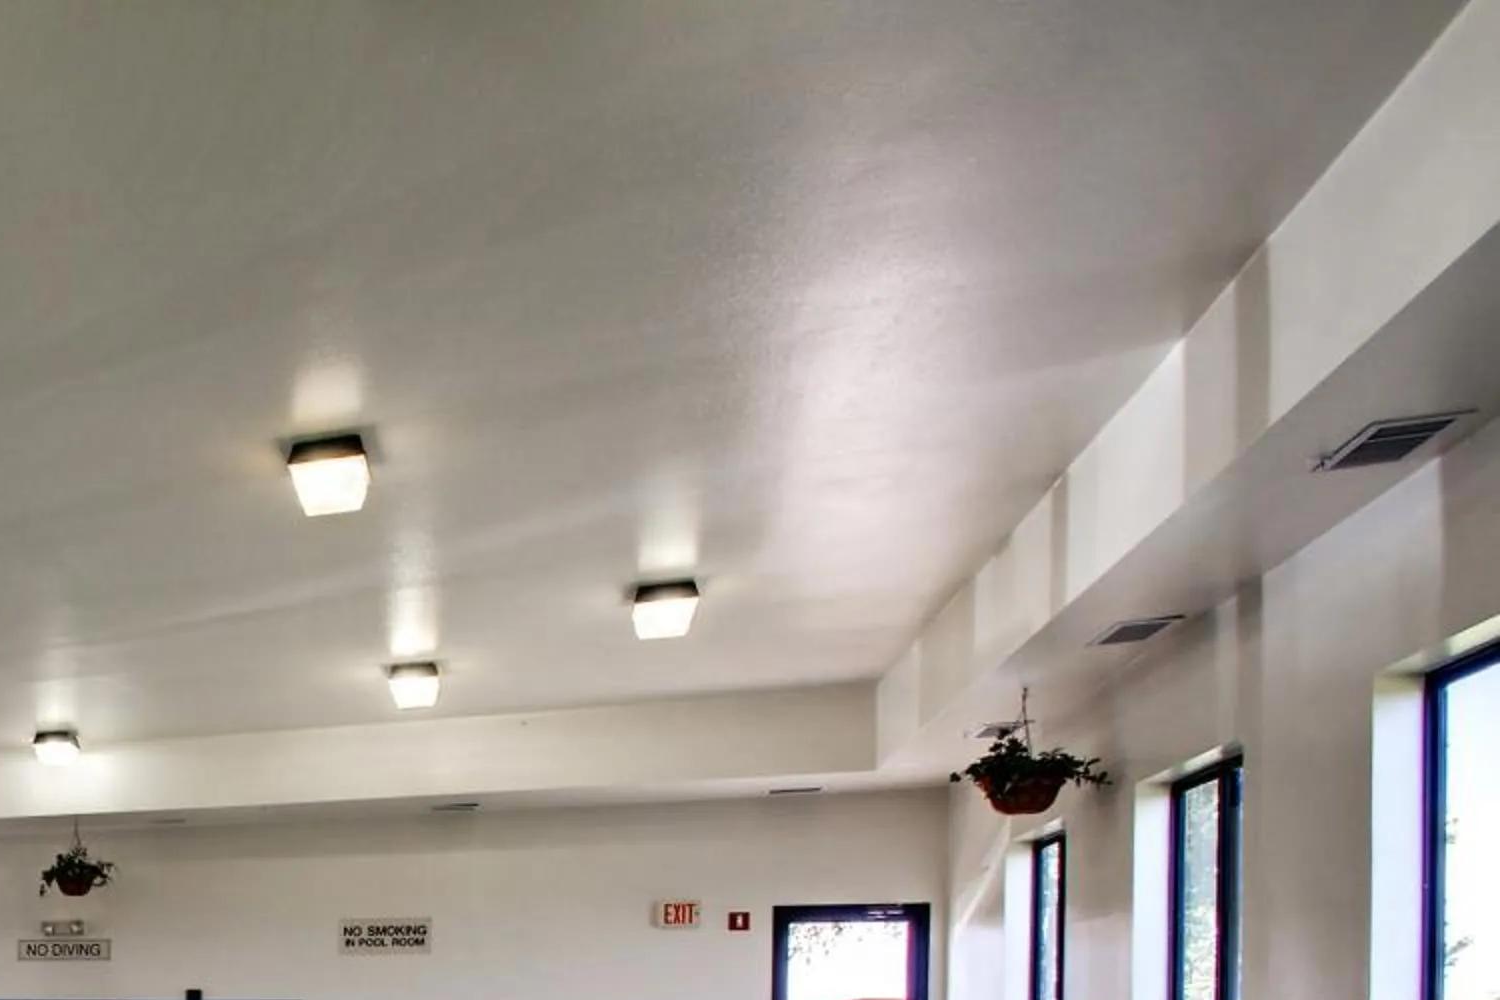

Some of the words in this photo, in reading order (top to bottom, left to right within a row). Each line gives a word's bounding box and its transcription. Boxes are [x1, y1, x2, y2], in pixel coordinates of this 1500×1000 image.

[664, 903, 697, 924] EXIT
[343, 926, 362, 936] NO
[367, 925, 427, 936] SMOKING
[359, 938, 388, 947] POOL
[392, 938, 425, 947] ROOM
[27, 943, 49, 956] NO
[52, 943, 100, 956] DIVING
